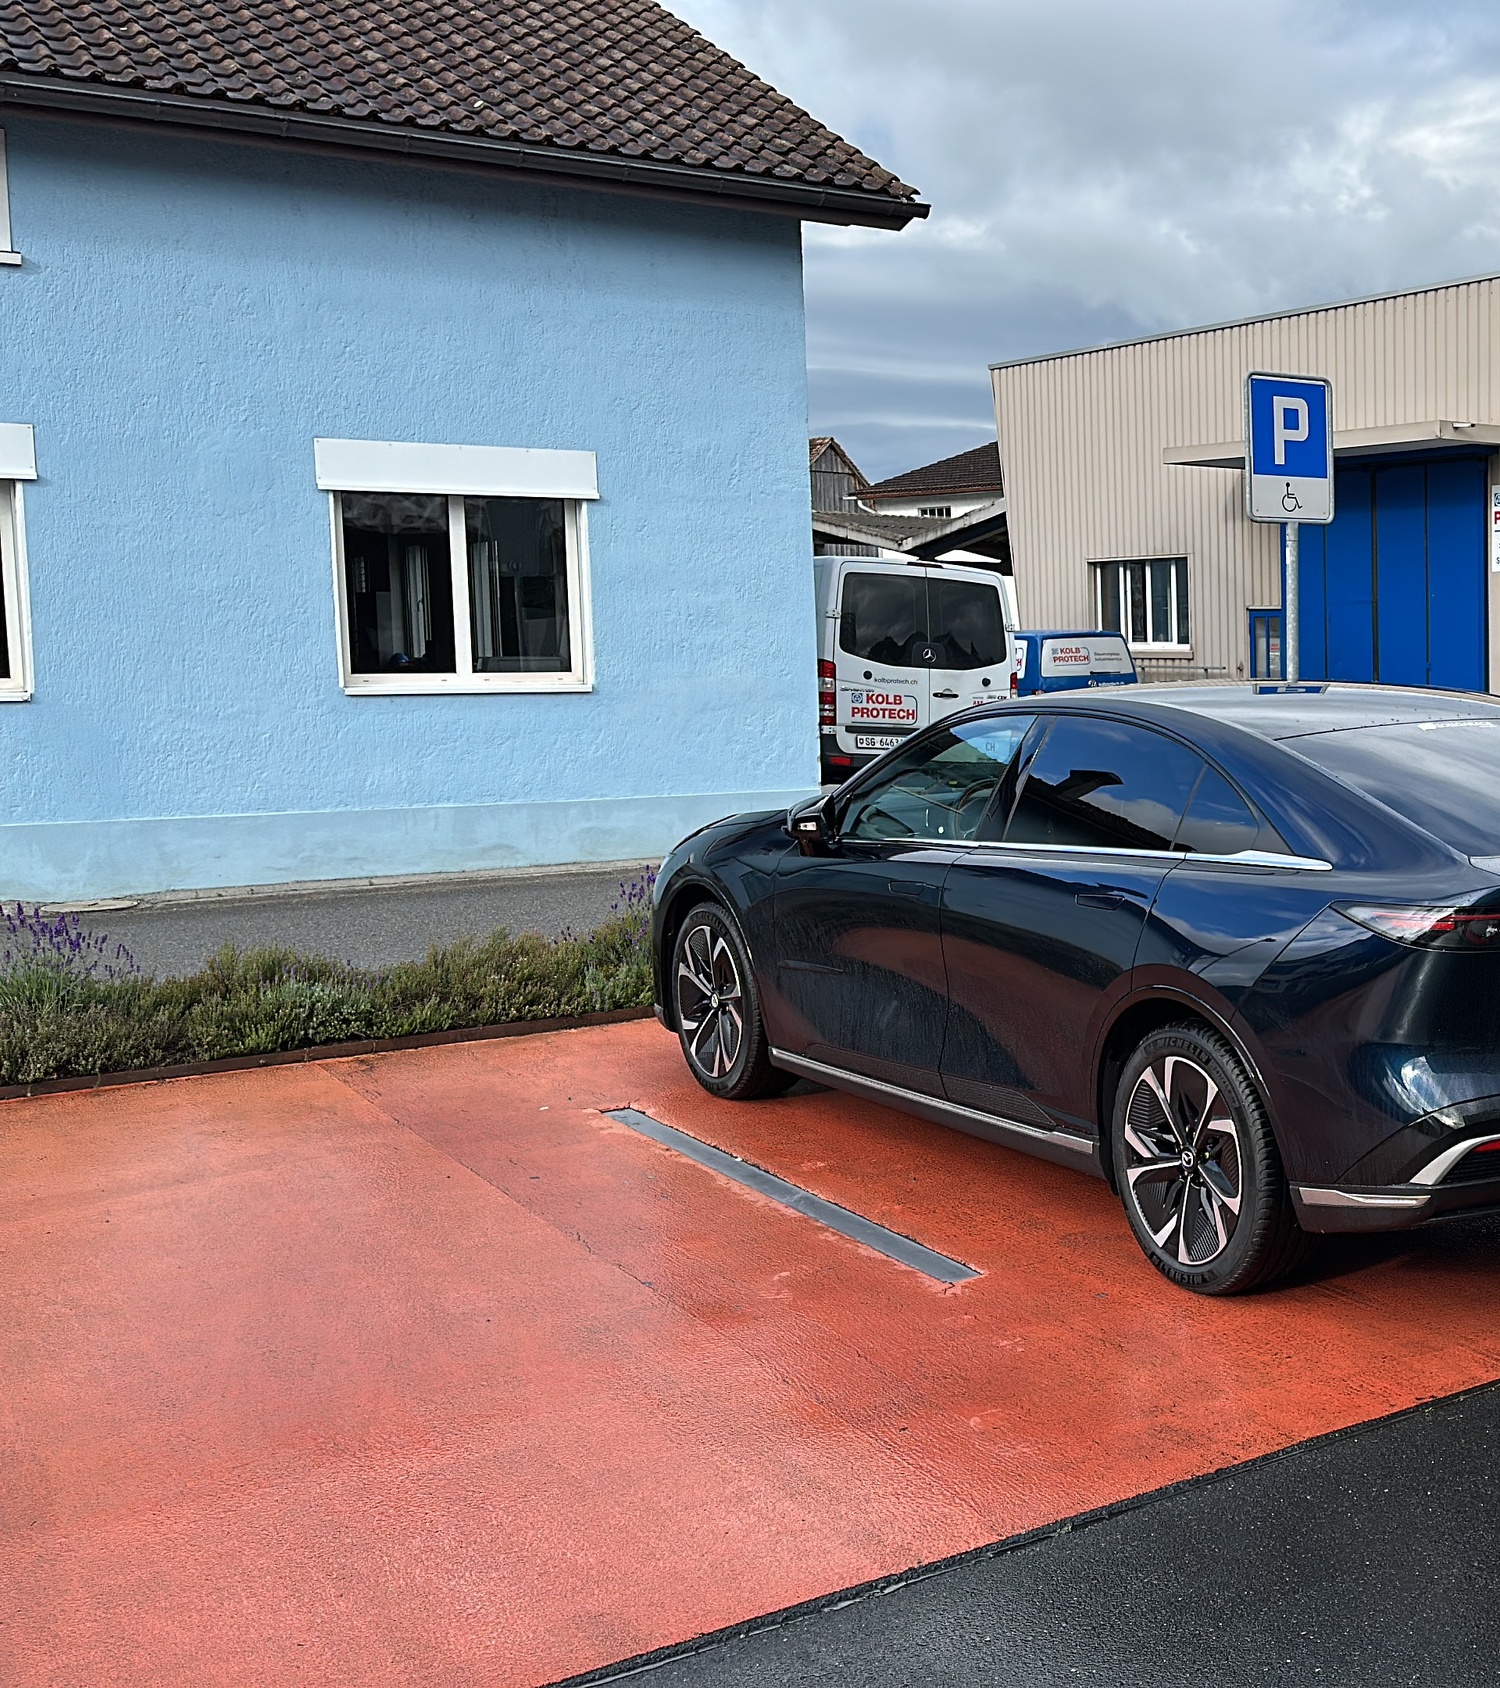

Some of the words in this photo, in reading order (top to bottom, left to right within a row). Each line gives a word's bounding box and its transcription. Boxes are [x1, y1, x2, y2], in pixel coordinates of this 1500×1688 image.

[1273, 395, 1309, 465] P
[1059, 647, 1081, 655] KOLB
[1053, 655, 1090, 663] PROTECH
[874, 677, 918, 686] kolbprotech.ch
[866, 693, 903, 706] KOLB
[851, 706, 916, 720] PROTECH
[1158, 1037, 1209, 1062] MICHELIN
